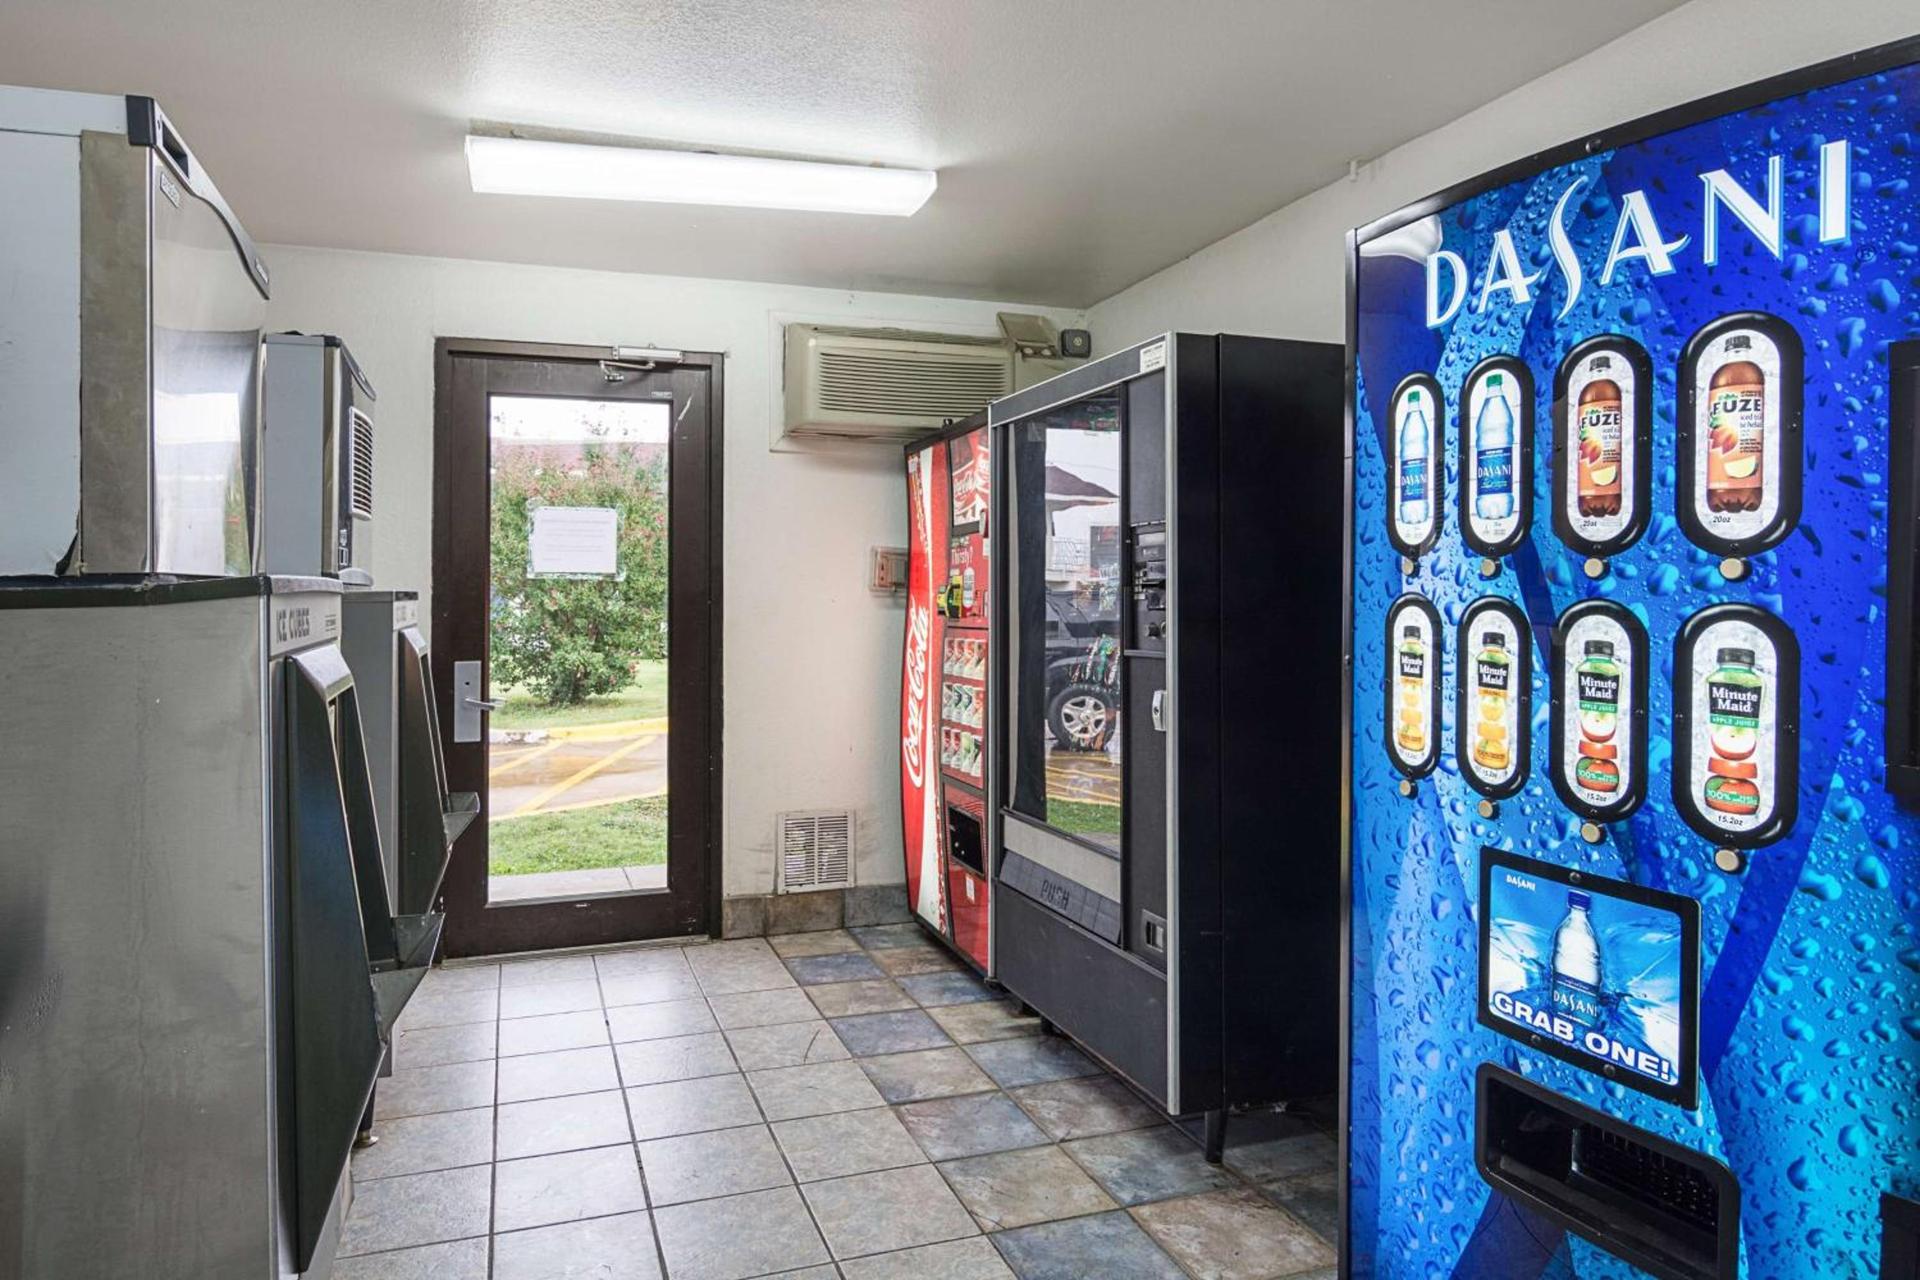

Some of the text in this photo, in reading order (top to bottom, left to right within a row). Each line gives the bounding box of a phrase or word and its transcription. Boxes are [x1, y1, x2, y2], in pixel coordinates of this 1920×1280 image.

[1426, 139, 1851, 328] DASANI
[1712, 399, 1762, 415] FUZE
[1581, 413, 1620, 429] FUZE
[1478, 464, 1512, 478] DASANI
[276, 609, 288, 643] ICE
[289, 607, 311, 640] CUBES
[1479, 664, 1507, 677] Minute
[1482, 674, 1504, 686] Maid
[1580, 676, 1618, 690] Minute
[903, 595, 929, 788] Coca-Cola
[1585, 688, 1614, 700] Maid
[1711, 686, 1759, 702] Minute
[1717, 698, 1753, 713] Maid
[1718, 815, 1744, 827] 15.2oz
[1506, 874, 1536, 892] DASANI
[1040, 879, 1070, 911] PUSH
[1553, 989, 1598, 1018] DASANI
[1494, 991, 1671, 1082] GRAB ONE!
